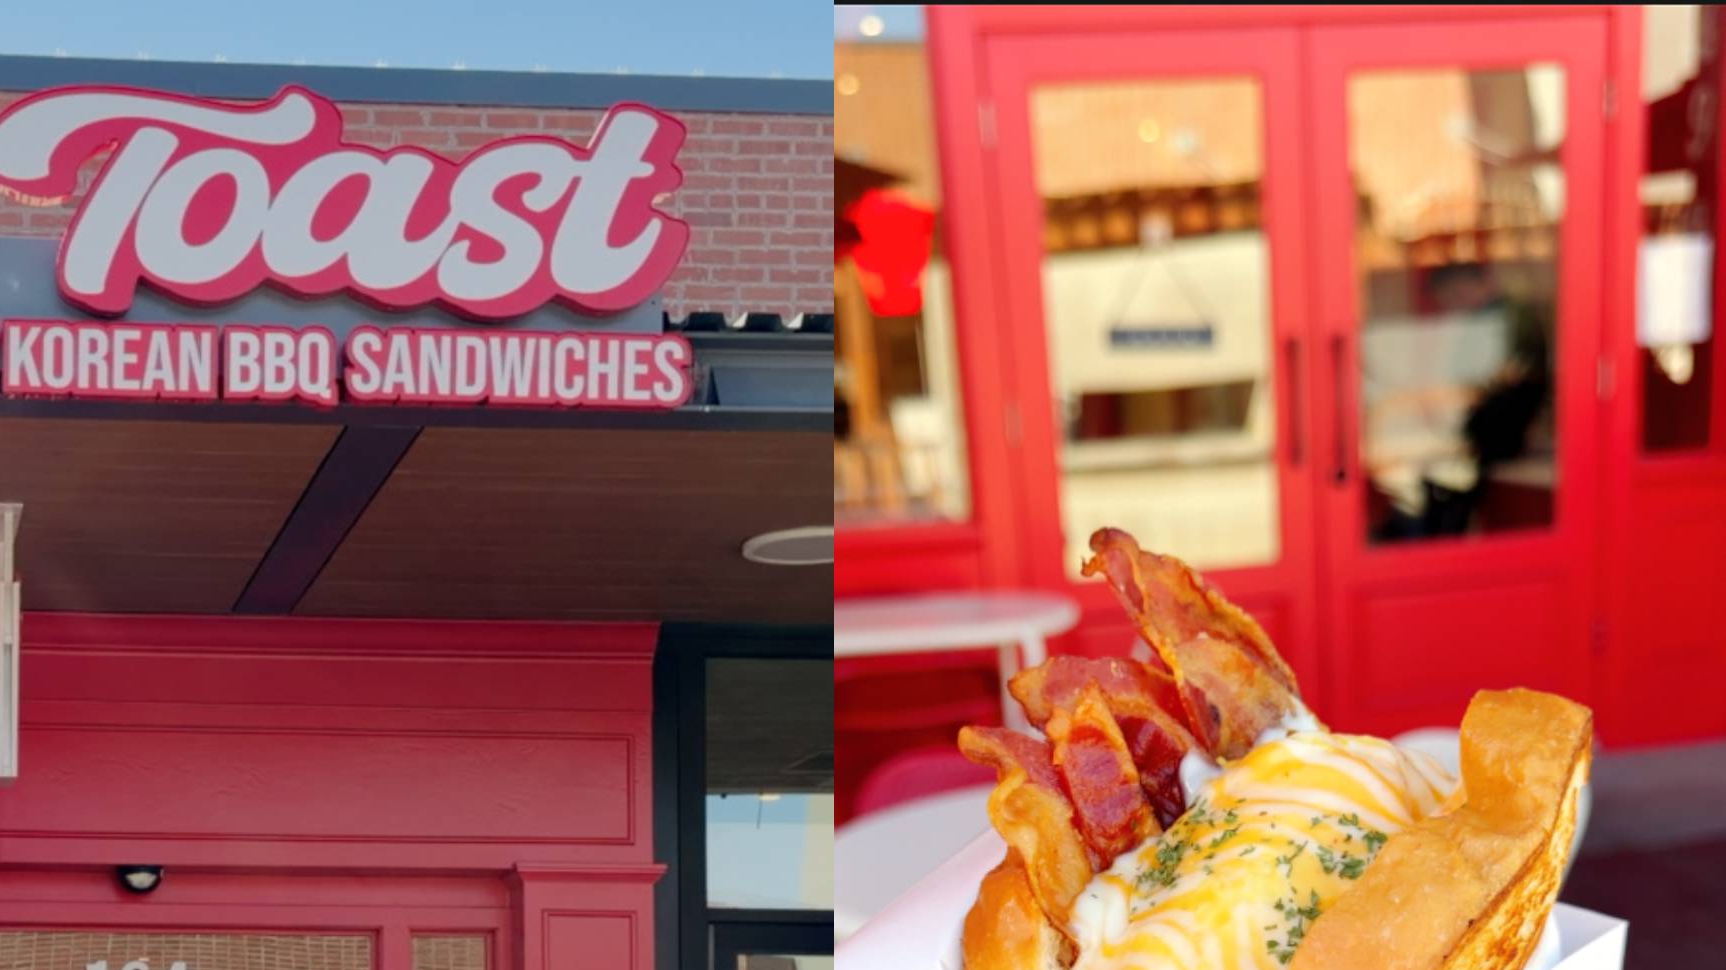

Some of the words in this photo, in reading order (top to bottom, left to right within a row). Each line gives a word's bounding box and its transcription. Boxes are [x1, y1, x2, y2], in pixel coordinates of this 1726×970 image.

[4, 325, 213, 393] KOREAN
[228, 331, 333, 399] BBQ
[349, 334, 686, 402] SANDWICHES
